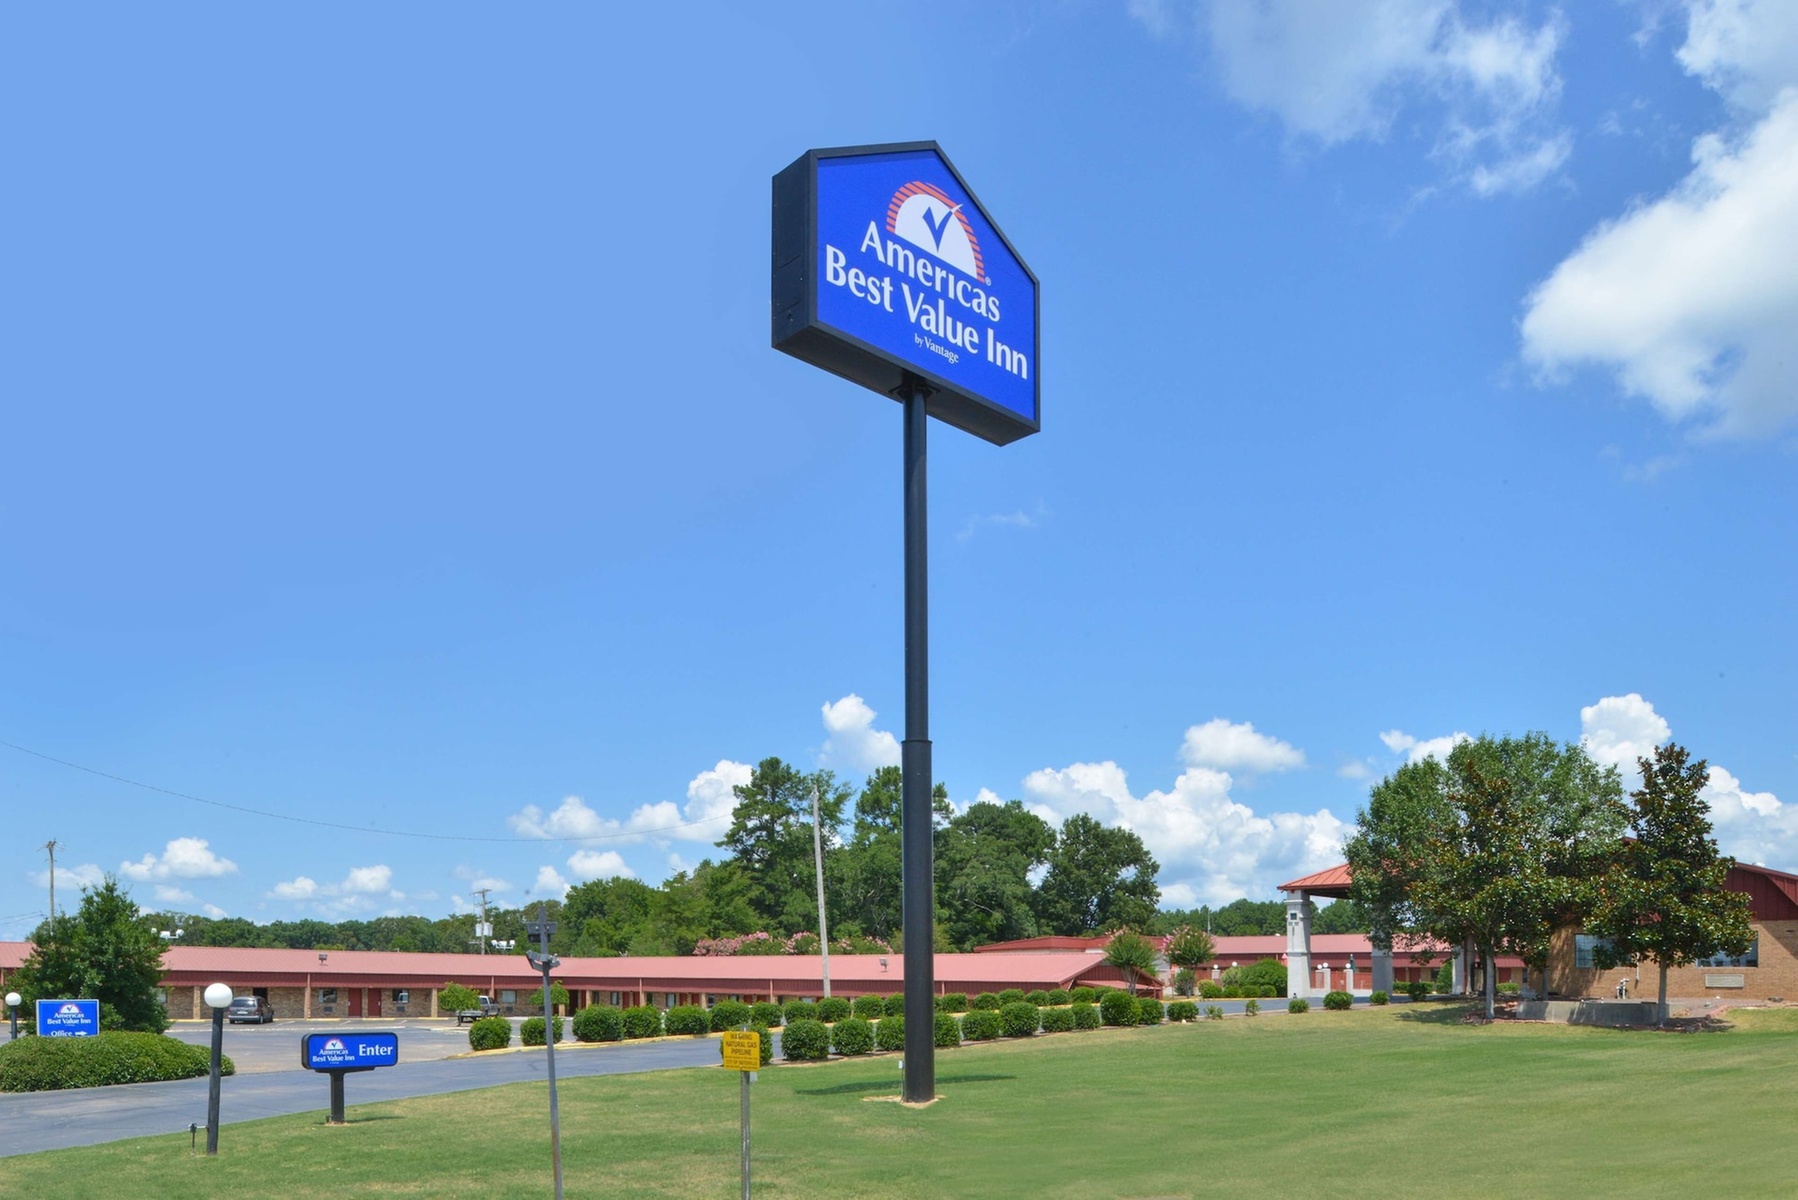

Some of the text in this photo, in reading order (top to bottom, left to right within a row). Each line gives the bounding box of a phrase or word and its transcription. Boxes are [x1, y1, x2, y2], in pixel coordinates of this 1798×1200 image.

[860, 220, 1001, 323] Americas
[826, 244, 1028, 380] Best Value Inn
[914, 333, 959, 364] by Vantage
[327, 1054, 344, 1062] Value
[358, 1044, 393, 1056] Enter
